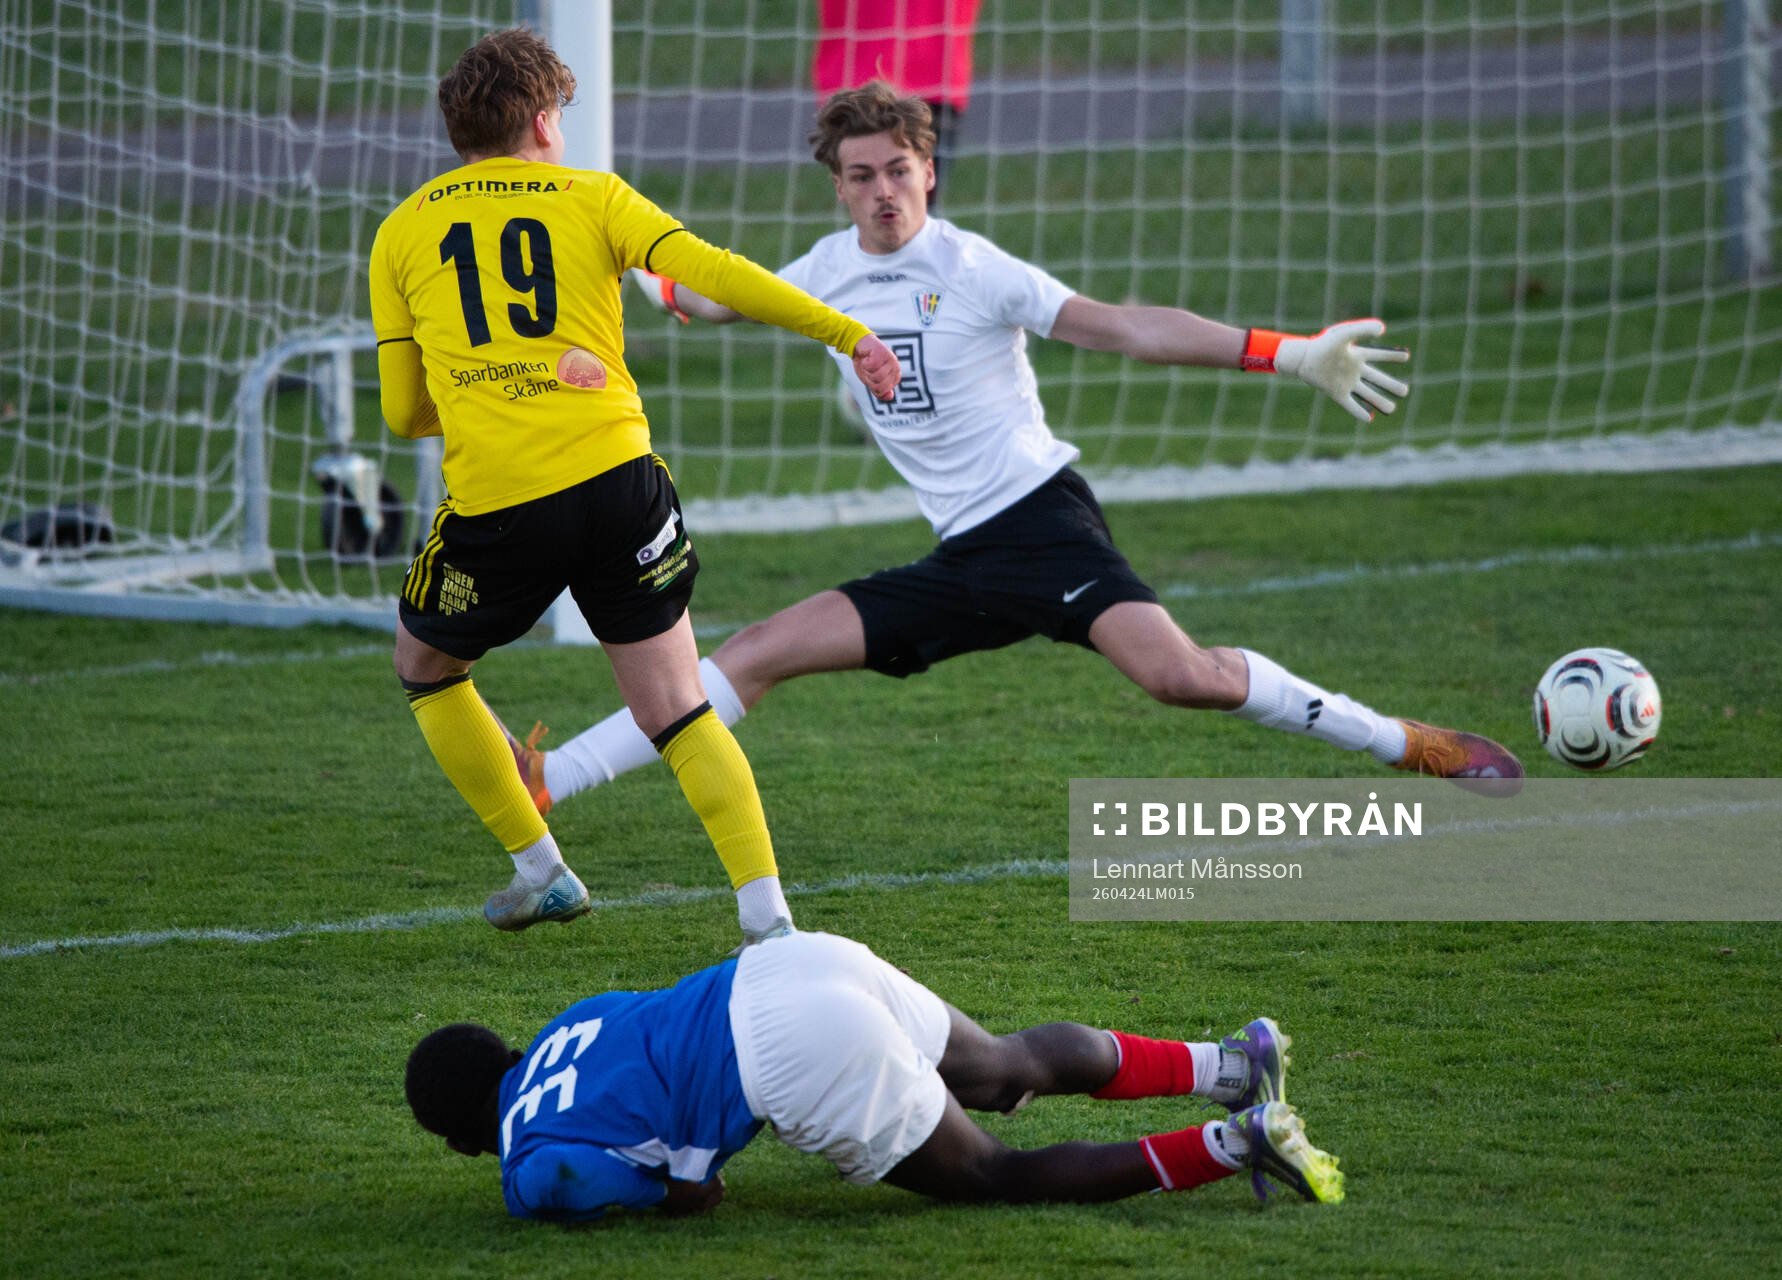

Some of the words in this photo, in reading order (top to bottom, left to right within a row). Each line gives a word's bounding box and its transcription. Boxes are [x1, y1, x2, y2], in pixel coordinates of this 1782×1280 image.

[428, 180, 559, 202] OPTIMERA
[439, 217, 558, 348] 19
[450, 360, 549, 389] Sparbanken
[503, 377, 560, 400] Skåne
[442, 577, 479, 604] SMUTS
[443, 568, 474, 590] INGEN
[440, 590, 467, 612] BARA
